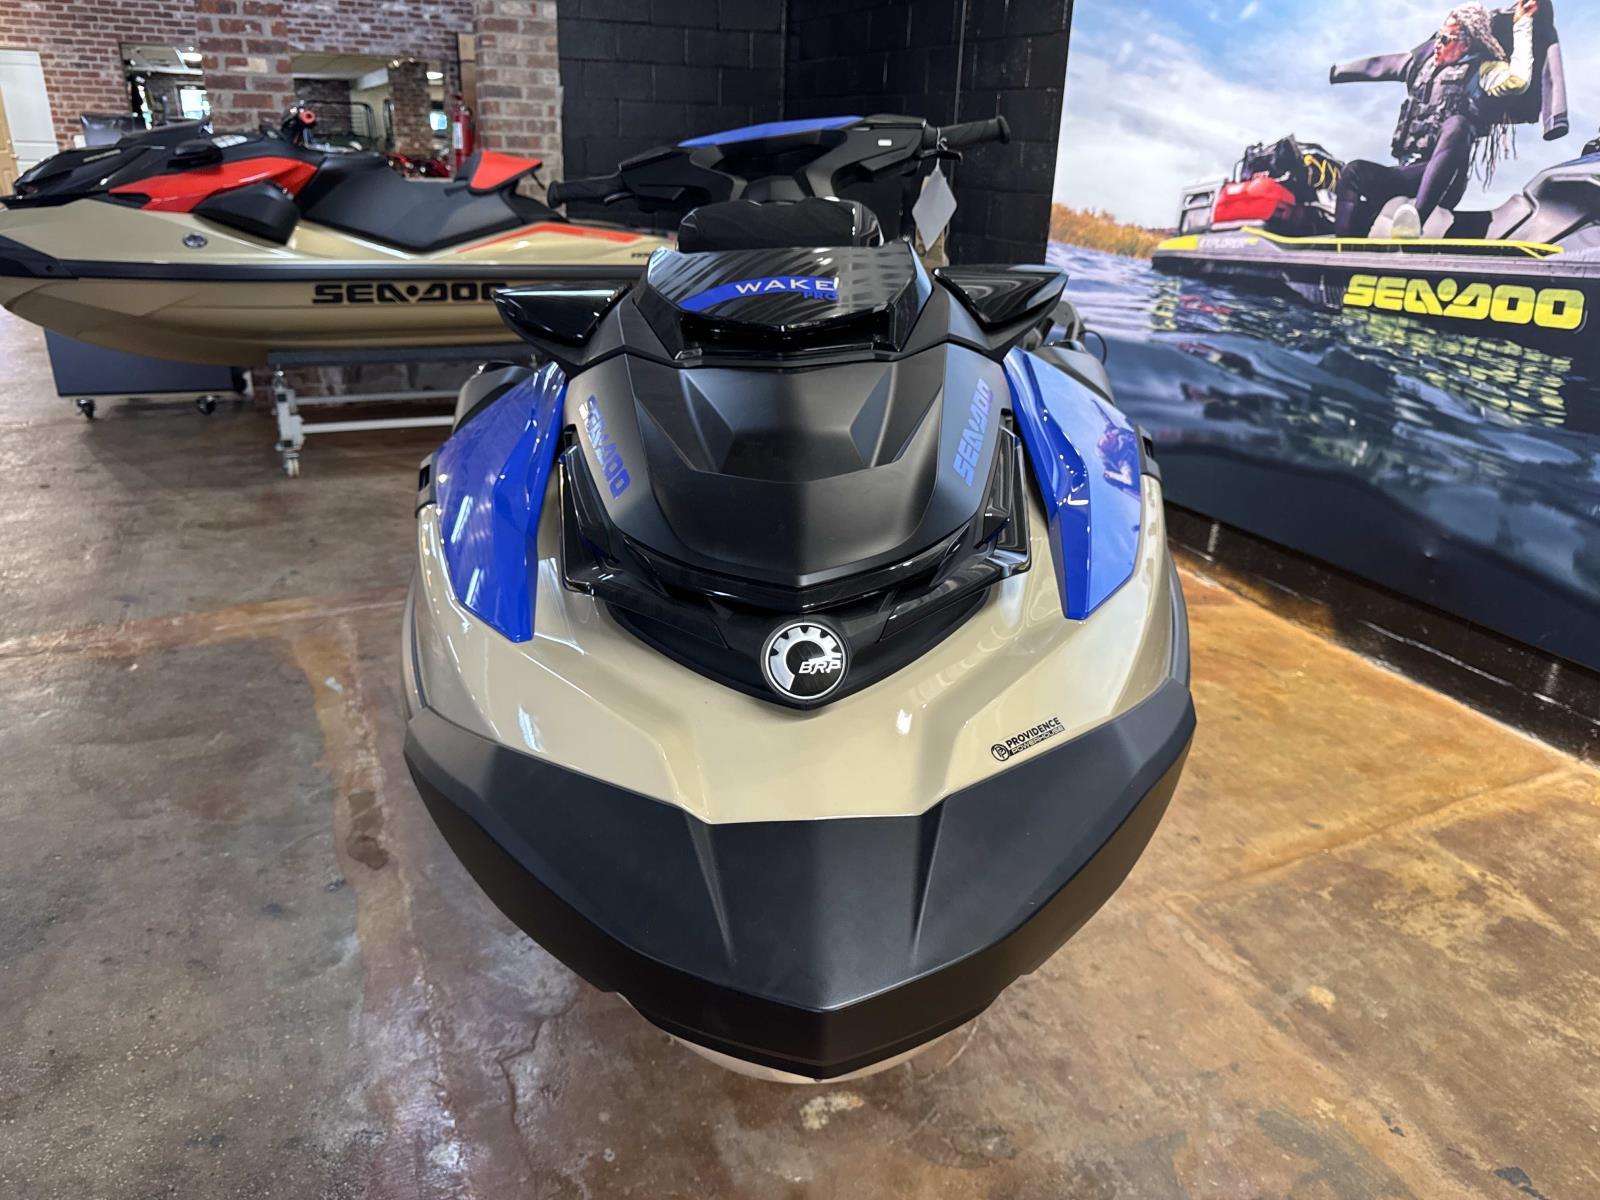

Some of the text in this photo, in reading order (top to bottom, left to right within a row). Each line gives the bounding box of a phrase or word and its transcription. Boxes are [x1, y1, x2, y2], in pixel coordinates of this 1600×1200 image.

[735, 279, 834, 294] WAKE
[803, 291, 838, 301] PRO
[798, 660, 842, 674] BRP
[1005, 717, 1061, 748] PROVIDENCE
